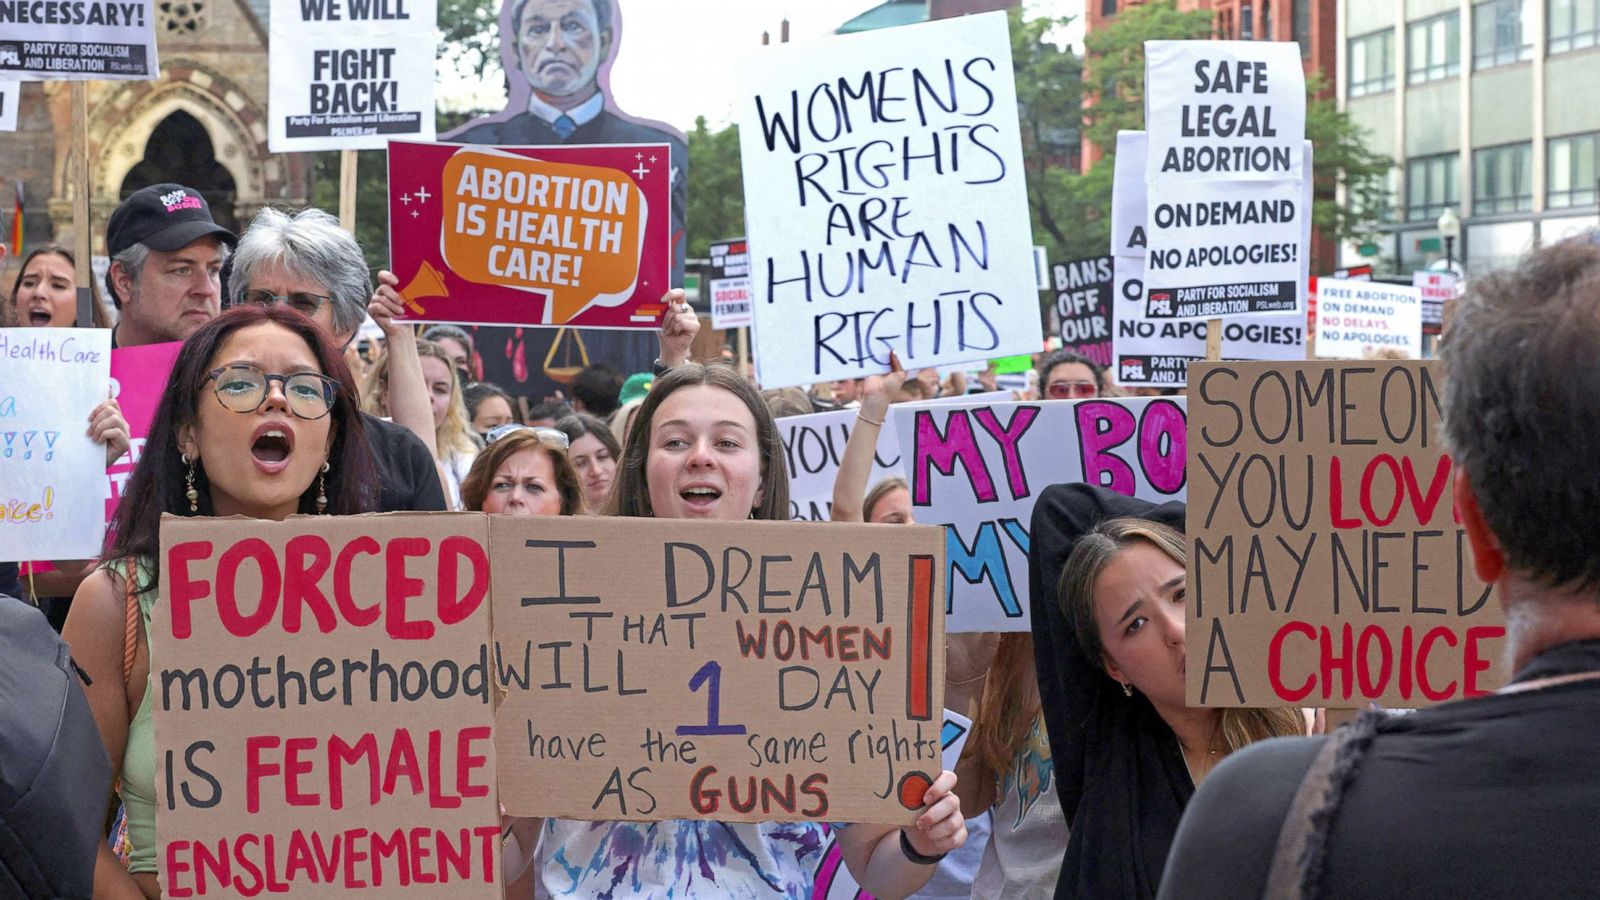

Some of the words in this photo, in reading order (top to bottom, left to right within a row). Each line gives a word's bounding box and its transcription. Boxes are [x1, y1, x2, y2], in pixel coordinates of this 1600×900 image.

[0, 1, 144, 27] NECESSARY!
[300, 0, 341, 21] WE
[348, 0, 410, 20] WILL
[23, 43, 56, 56] PARTY
[58, 44, 77, 56] FOR
[80, 45, 130, 57] SOCIALISM
[24, 57, 44, 69] AND
[46, 59, 105, 71] LIBERATION
[314, 48, 396, 81] FIGHT
[1194, 59, 1269, 94] SAFE
[310, 81, 398, 114] BACK!
[755, 57, 995, 154] WOMENS
[290, 115, 311, 127] Party
[379, 112, 417, 122] Liberation
[1181, 104, 1277, 137] LEGAL
[795, 123, 1006, 207] RIGHTS
[1161, 146, 1291, 172] ABORTION
[456, 164, 629, 216] ABORTION
[455, 202, 487, 236] IS
[495, 208, 623, 254] HEALTH
[826, 197, 918, 246] ARE
[1154, 203, 1192, 229] ON
[1195, 199, 1295, 226] DEMAND
[487, 244, 583, 287] CARE!
[767, 220, 988, 303] HUMAN
[1150, 248, 1182, 270] NO
[1185, 243, 1297, 267] APOLOGIES!
[1053, 257, 1112, 291] BANS
[1058, 288, 1099, 317] OFF
[1149, 299, 1173, 316] PSL
[1176, 305, 1197, 318] AND
[1198, 300, 1249, 316] LIBERATION
[1255, 301, 1294, 311] PSLweb.org
[1177, 288, 1206, 303] PARTY
[1208, 286, 1226, 300] FOR
[1227, 283, 1279, 298] SOCIALISM
[1323, 288, 1352, 298] FREE
[1356, 289, 1416, 304] ABORTION
[1323, 302, 1340, 312] ON
[1344, 303, 1394, 315] DEMAND
[814, 290, 1002, 375] RIGHTS
[1062, 315, 1109, 342] OUR
[1119, 320, 1155, 338] NO
[1160, 321, 1302, 346] APOOGIES!
[1322, 317, 1340, 326] NO
[1344, 317, 1390, 329] DELAYS.
[1322, 331, 1340, 341] NO
[1344, 332, 1411, 346] APOLOGIES.
[59, 337, 101, 363] Care
[1151, 356, 1189, 369] PARTY
[1121, 364, 1146, 380] PSL
[1150, 370, 1180, 383] AND
[912, 405, 1042, 507] MY
[1197, 452, 1313, 531] YOU
[1329, 453, 1462, 528] LOV
[168, 535, 490, 640] FORCED
[521, 539, 601, 606] I
[664, 541, 884, 624] DREAM
[1195, 532, 1317, 618] MAY
[1331, 529, 1494, 617] NEED
[569, 612, 706, 649] THAT
[735, 619, 892, 661] WOMEN
[161, 643, 489, 711] motherhood
[1200, 617, 1246, 704] A
[1268, 620, 1506, 702] CHOICE
[496, 640, 648, 696] WILL
[675, 660, 747, 736] 1
[778, 664, 882, 714] DAY
[165, 740, 223, 811] IS
[246, 726, 492, 814] FEMALE
[527, 719, 607, 761] have
[641, 727, 697, 763] the
[747, 732, 828, 768] same
[848, 718, 937, 800] rights
[591, 767, 657, 815] AS
[689, 765, 829, 817] GUNS
[166, 826, 501, 898] ENSLAVEMENT
